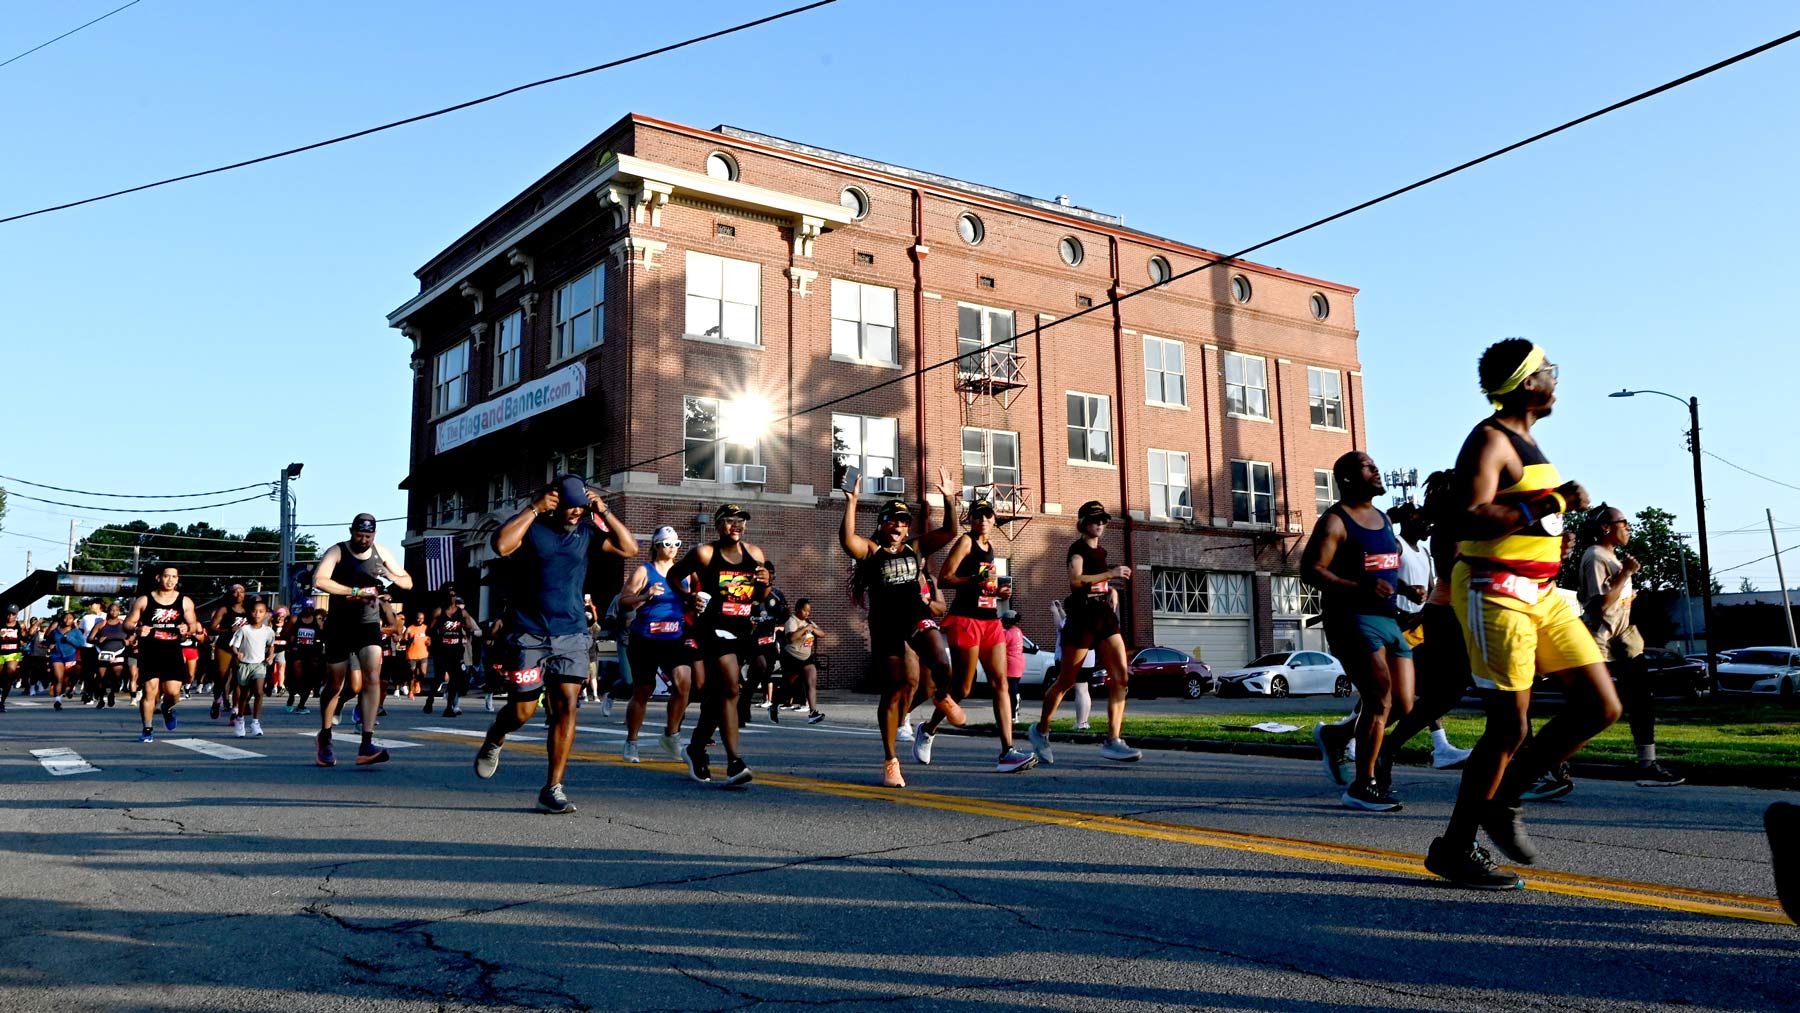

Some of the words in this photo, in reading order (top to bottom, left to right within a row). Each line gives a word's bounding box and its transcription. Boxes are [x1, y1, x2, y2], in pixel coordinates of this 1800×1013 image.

[446, 424, 459, 441] The
[1383, 554, 1399, 568] 297
[664, 621, 680, 632] 409
[515, 669, 538, 684] 369
